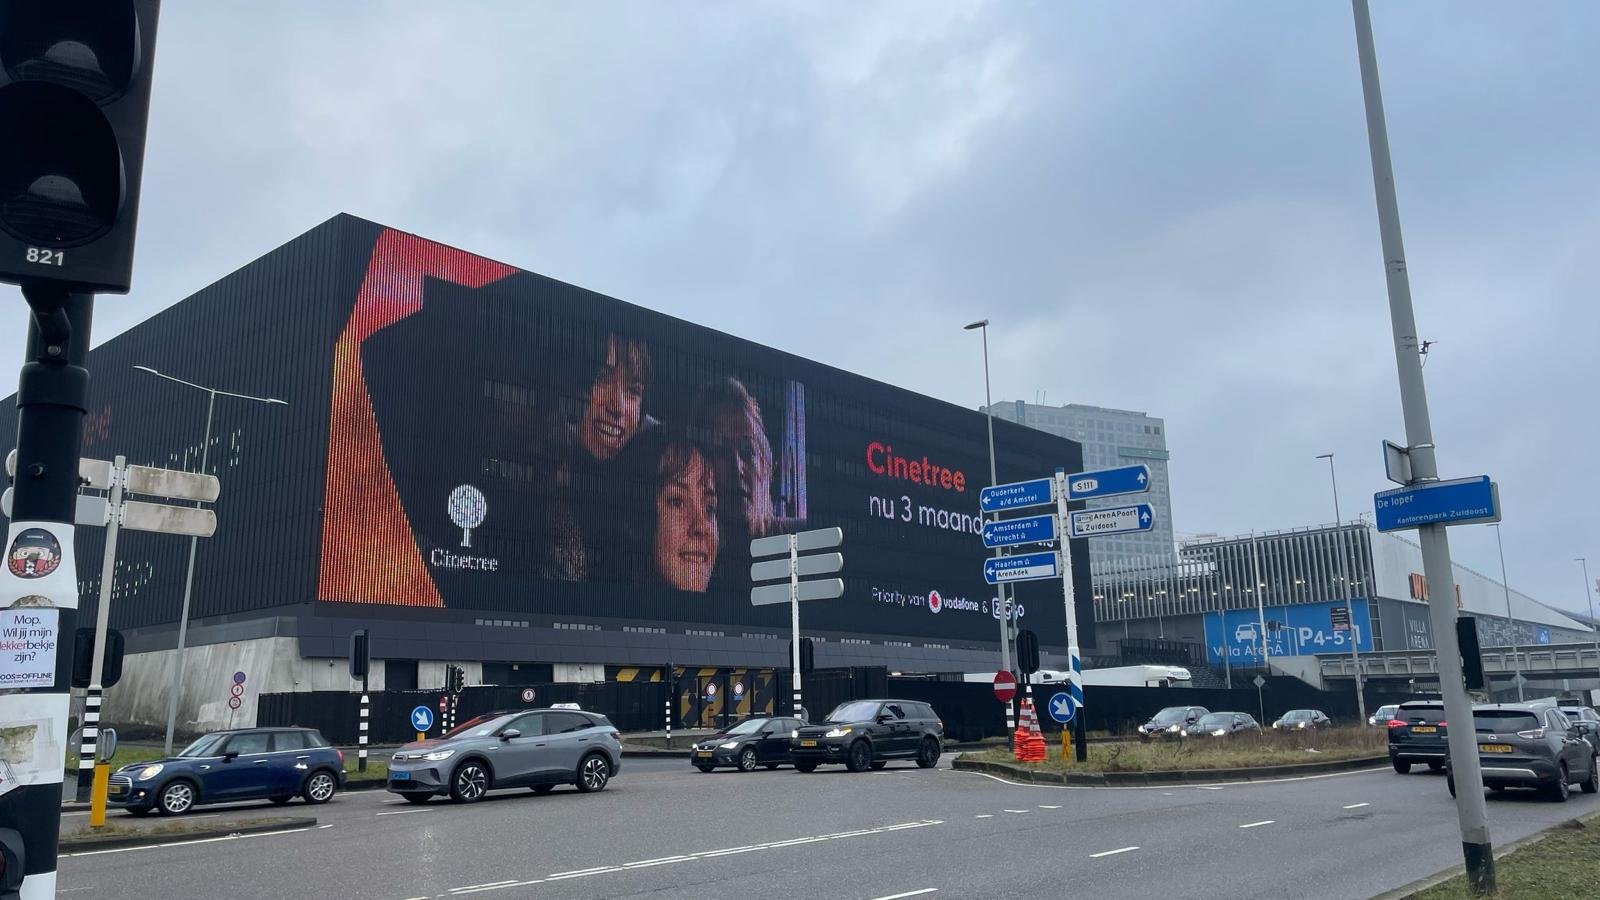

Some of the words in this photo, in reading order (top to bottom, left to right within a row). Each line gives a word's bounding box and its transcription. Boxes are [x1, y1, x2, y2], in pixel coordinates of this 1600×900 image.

[26, 247, 64, 266] 821
[866, 440, 966, 492] Cinetree
[990, 487, 1025, 498] Ouderkerk
[1000, 498, 1012, 506] a/d
[1013, 494, 1038, 505] Amstel
[1377, 500, 1389, 509] De
[869, 495, 894, 519] nu
[901, 495, 913, 522] 3
[919, 505, 992, 536] maand
[1094, 509, 1137, 520] ArenAPoort
[1397, 511, 1447, 524] Kantorenpark
[1449, 507, 1488, 518] Zuidoost
[993, 522, 1032, 533] Amsterdam
[1085, 521, 1117, 531] Zuidoost
[993, 533, 1019, 543] Utrecht
[995, 559, 1024, 569] Haarlem
[997, 569, 1029, 578] ArenAdek
[943, 597, 979, 612] vodafone
[14, 615, 41, 627] Mop.
[3, 628, 18, 638] Wil
[18, 627, 28, 640] jij
[29, 627, 52, 640] mijn
[1212, 645, 1240, 657] Vla
[14, 651, 37, 664] zijn?
